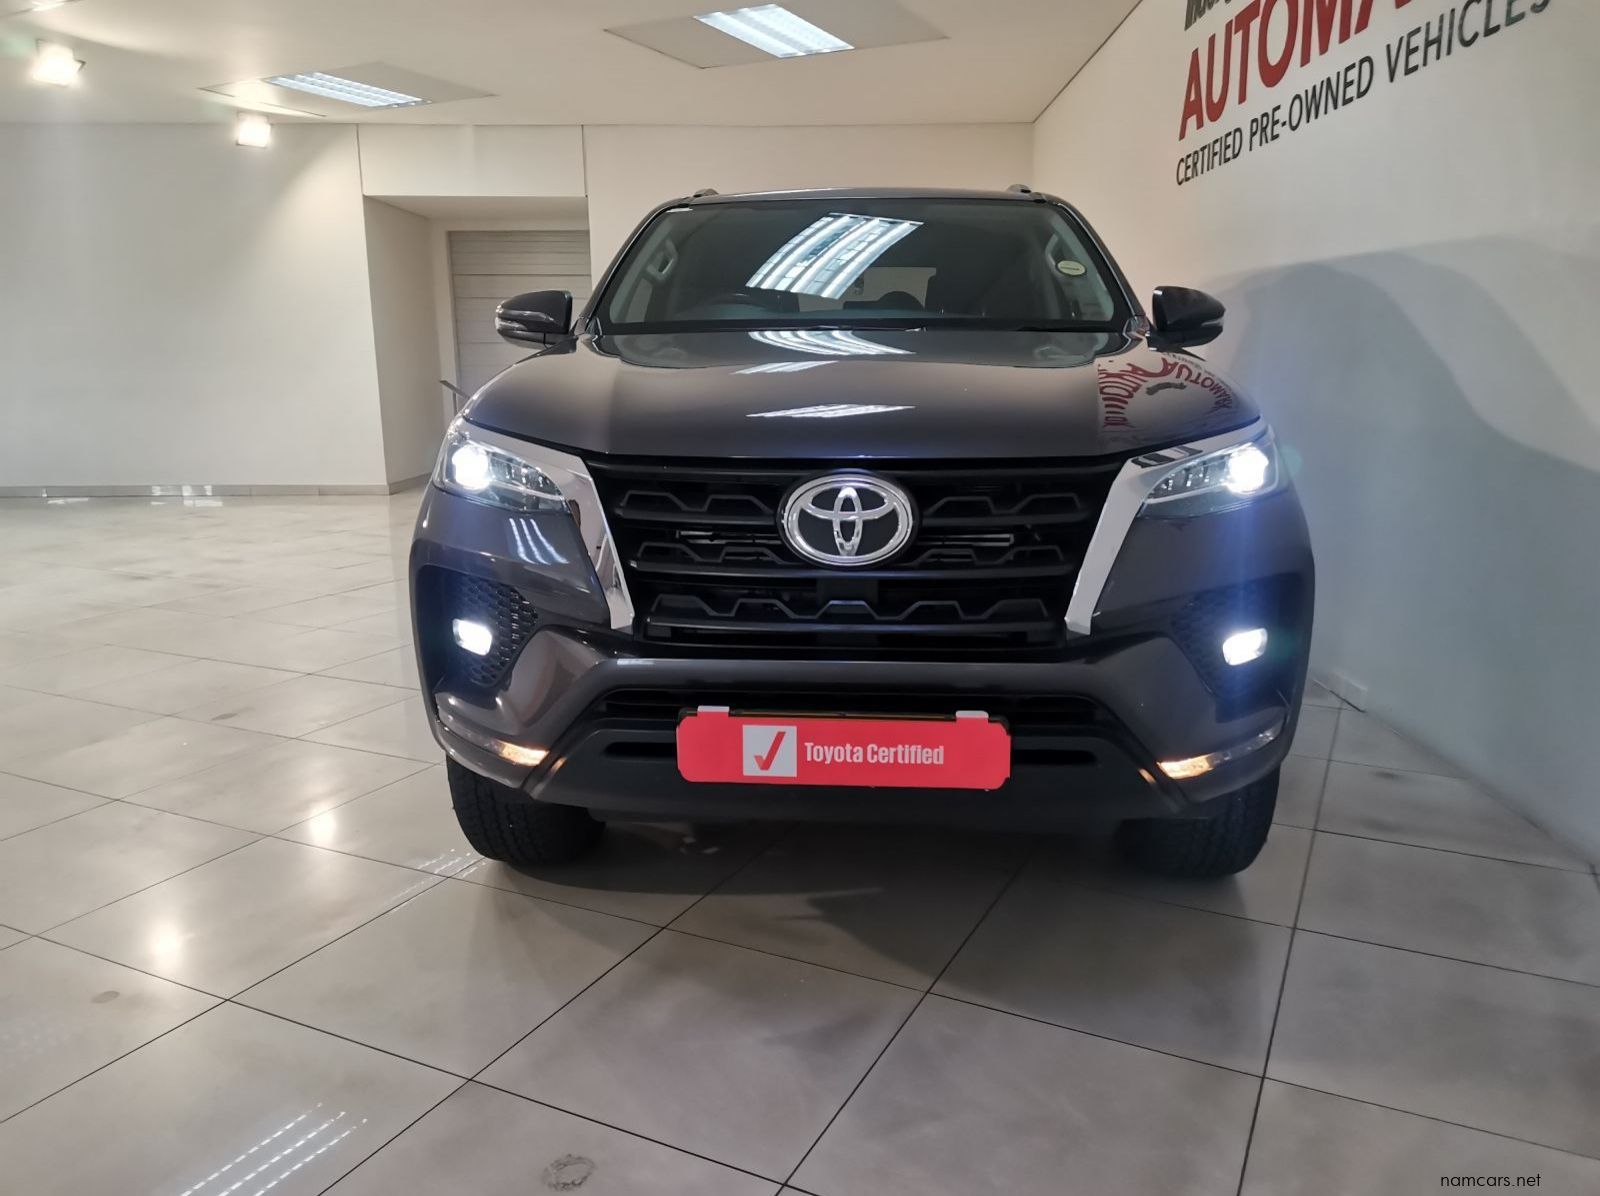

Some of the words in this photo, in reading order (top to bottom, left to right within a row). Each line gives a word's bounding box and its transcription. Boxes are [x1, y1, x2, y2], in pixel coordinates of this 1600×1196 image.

[1176, 127, 1243, 186] CERTIFIED
[1249, 56, 1374, 152] PRE-OWNED
[1386, 0, 1550, 83] VEHICL
[804, 742, 863, 764] Toyota
[866, 744, 944, 765] Certified
